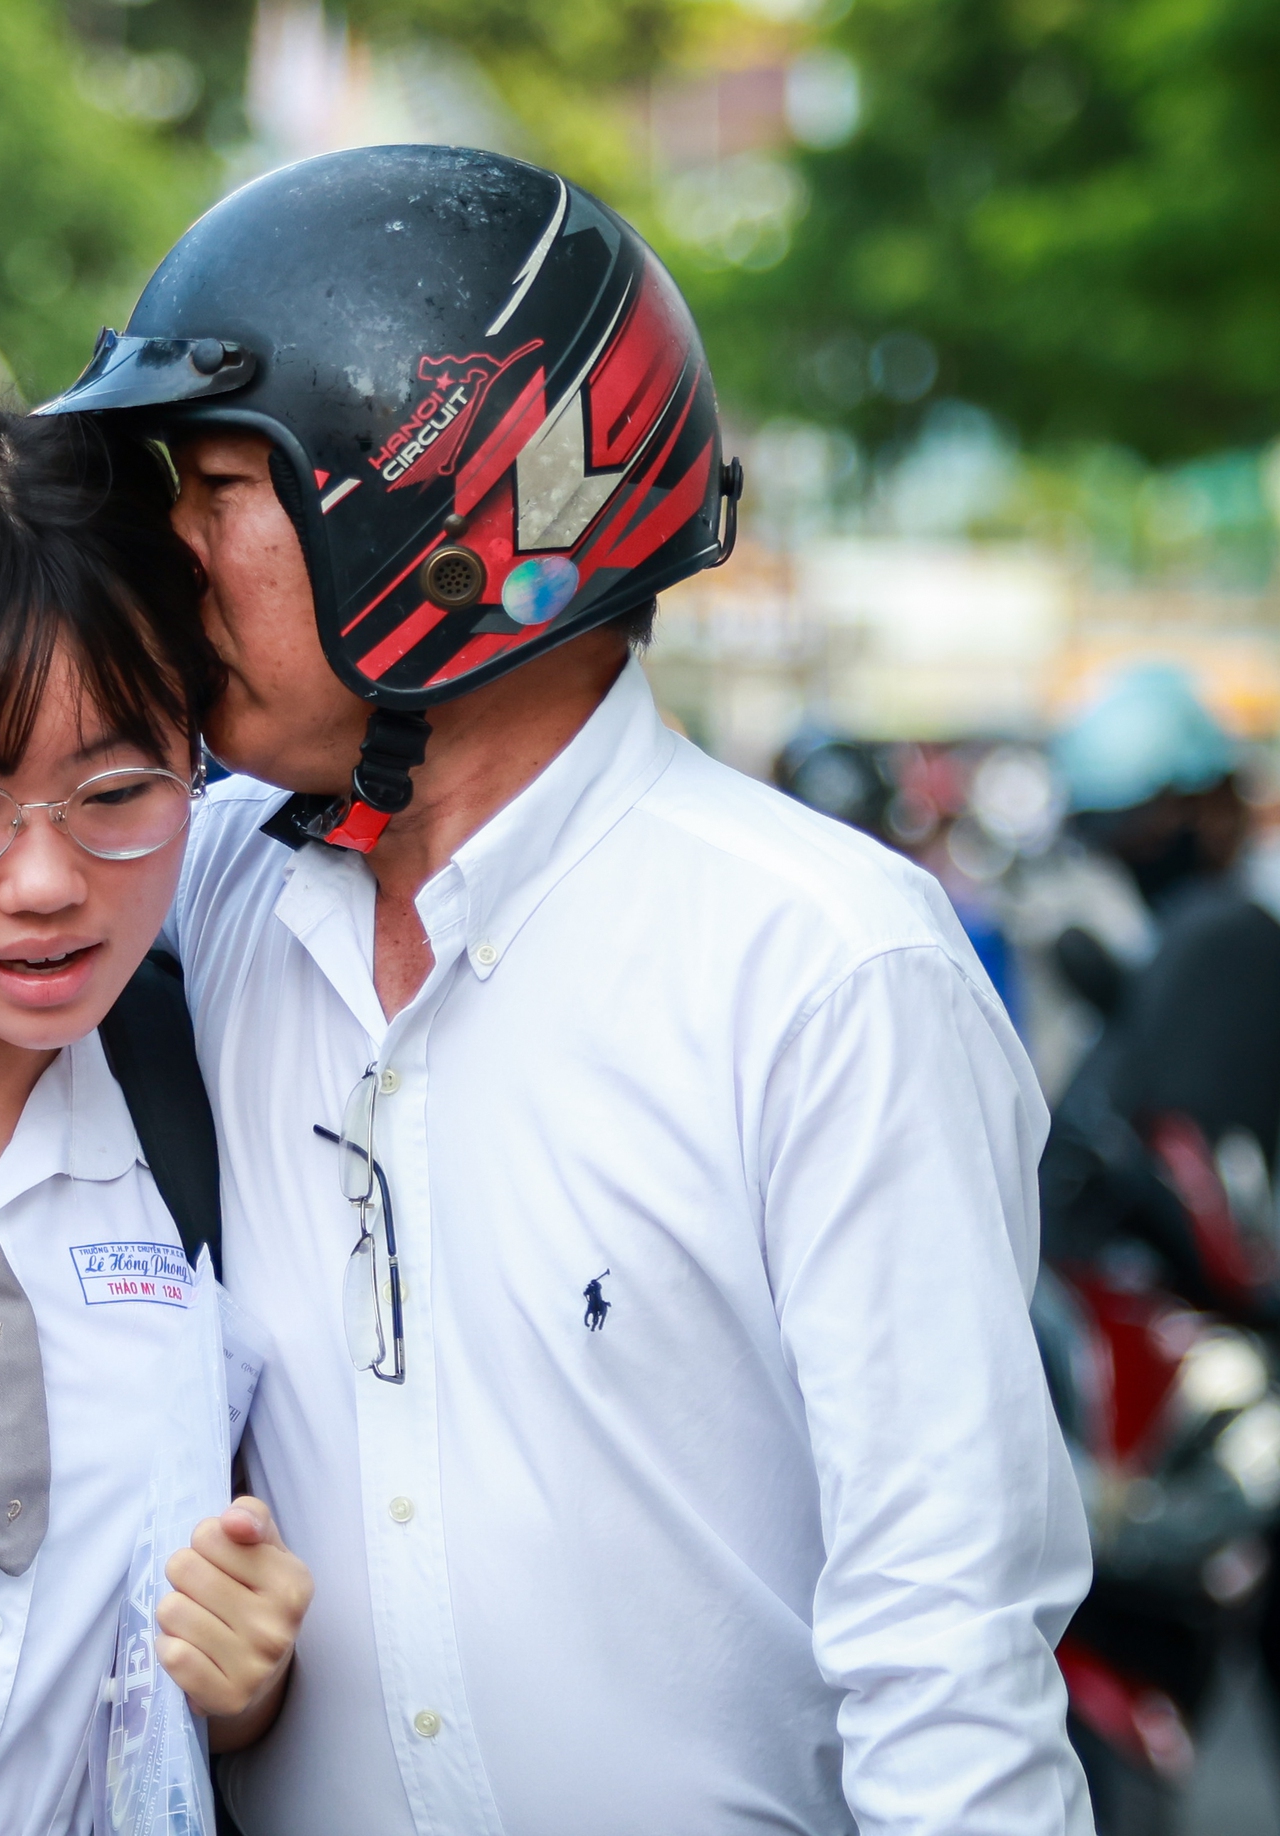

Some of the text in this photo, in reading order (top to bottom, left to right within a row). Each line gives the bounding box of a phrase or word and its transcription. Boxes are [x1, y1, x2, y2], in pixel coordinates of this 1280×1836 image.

[368, 391, 444, 470] HANOI
[382, 386, 468, 482] CIRCUIT
[85, 1255, 106, 1273] Lê
[151, 1254, 188, 1282] Phong
[107, 1278, 183, 1300] THẢO MY 12A3
